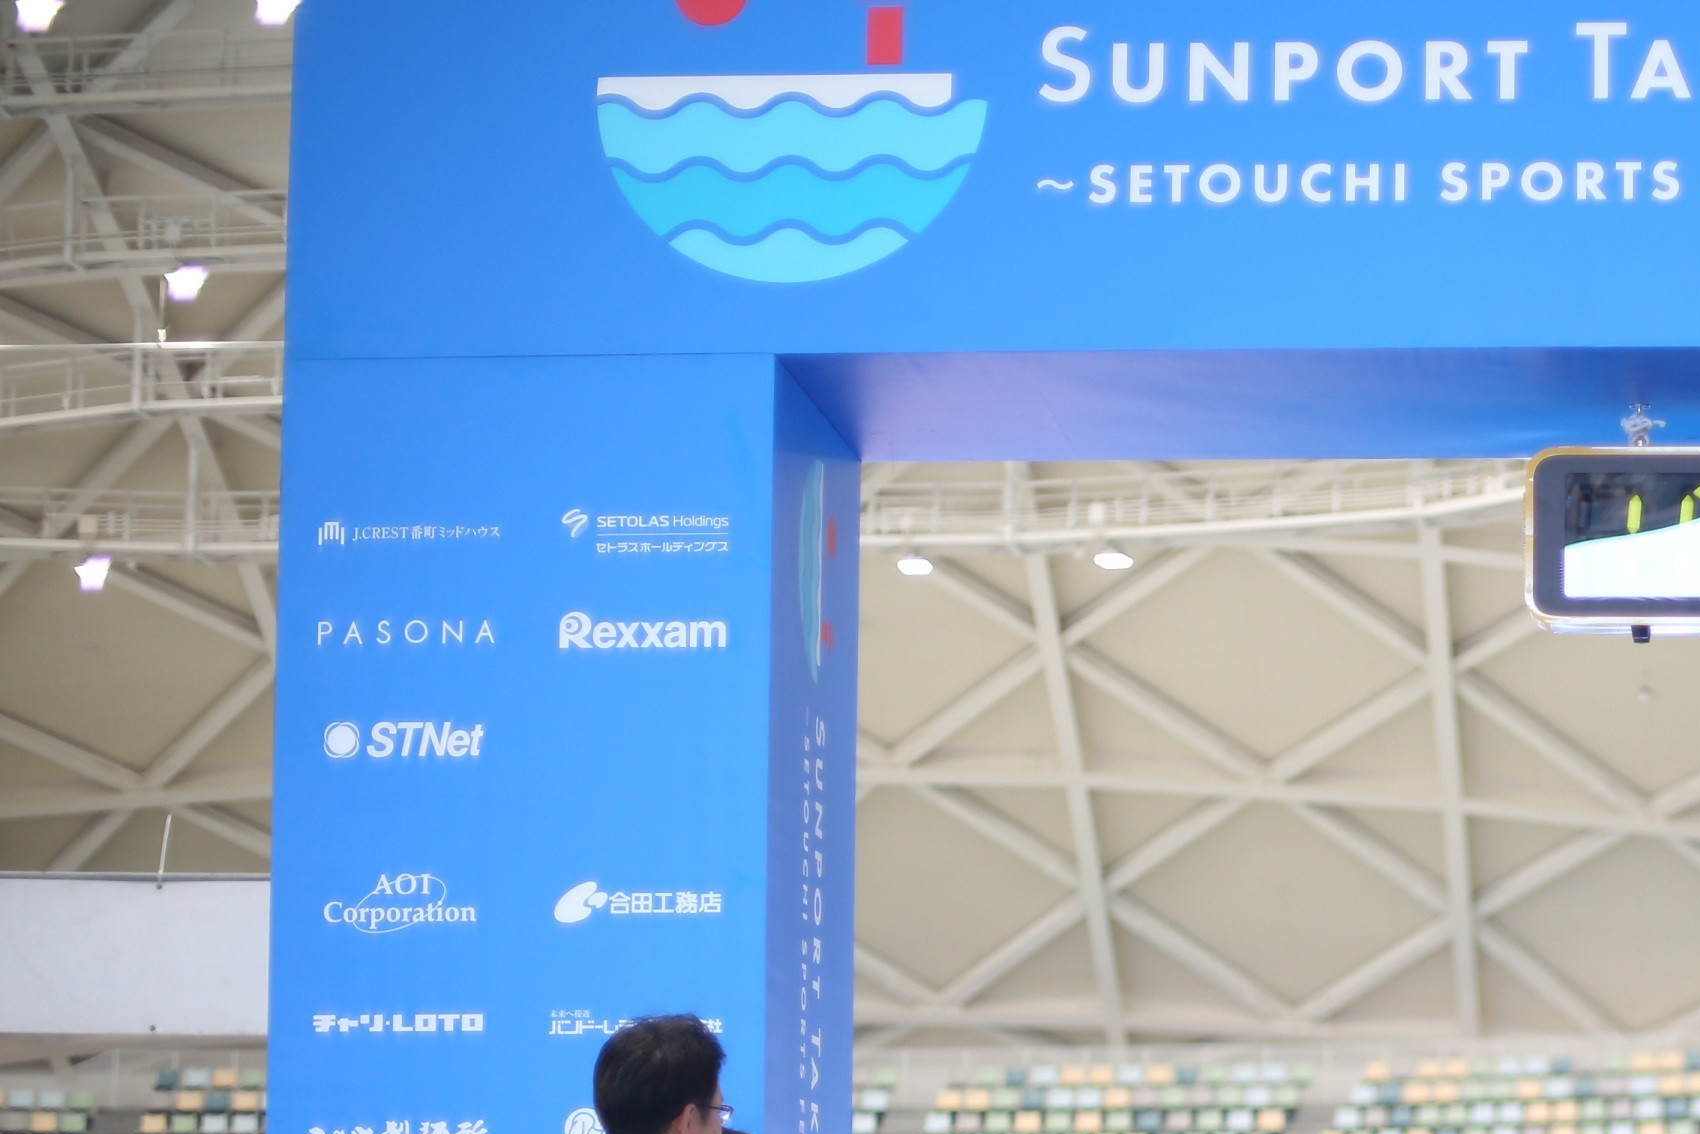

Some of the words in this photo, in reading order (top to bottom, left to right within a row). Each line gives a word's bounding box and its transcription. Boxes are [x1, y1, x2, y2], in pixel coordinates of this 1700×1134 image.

[1038, 25, 1529, 103] SUNPORT
[1440, 160, 1681, 202] SPORTS
[596, 515, 670, 528] SETOLAS
[673, 514, 729, 531] Holdings
[595, 541, 729, 554] セトラスホールディングス
[316, 619, 495, 646] PASONA
[558, 611, 728, 649] Rexxam
[366, 721, 484, 758] STNet
[812, 716, 826, 1000] SUNPORT
[371, 874, 431, 896] AOI
[323, 901, 477, 930] Corporation
[608, 891, 722, 915] 合田工務店
[799, 939, 808, 1080] SPORTS
